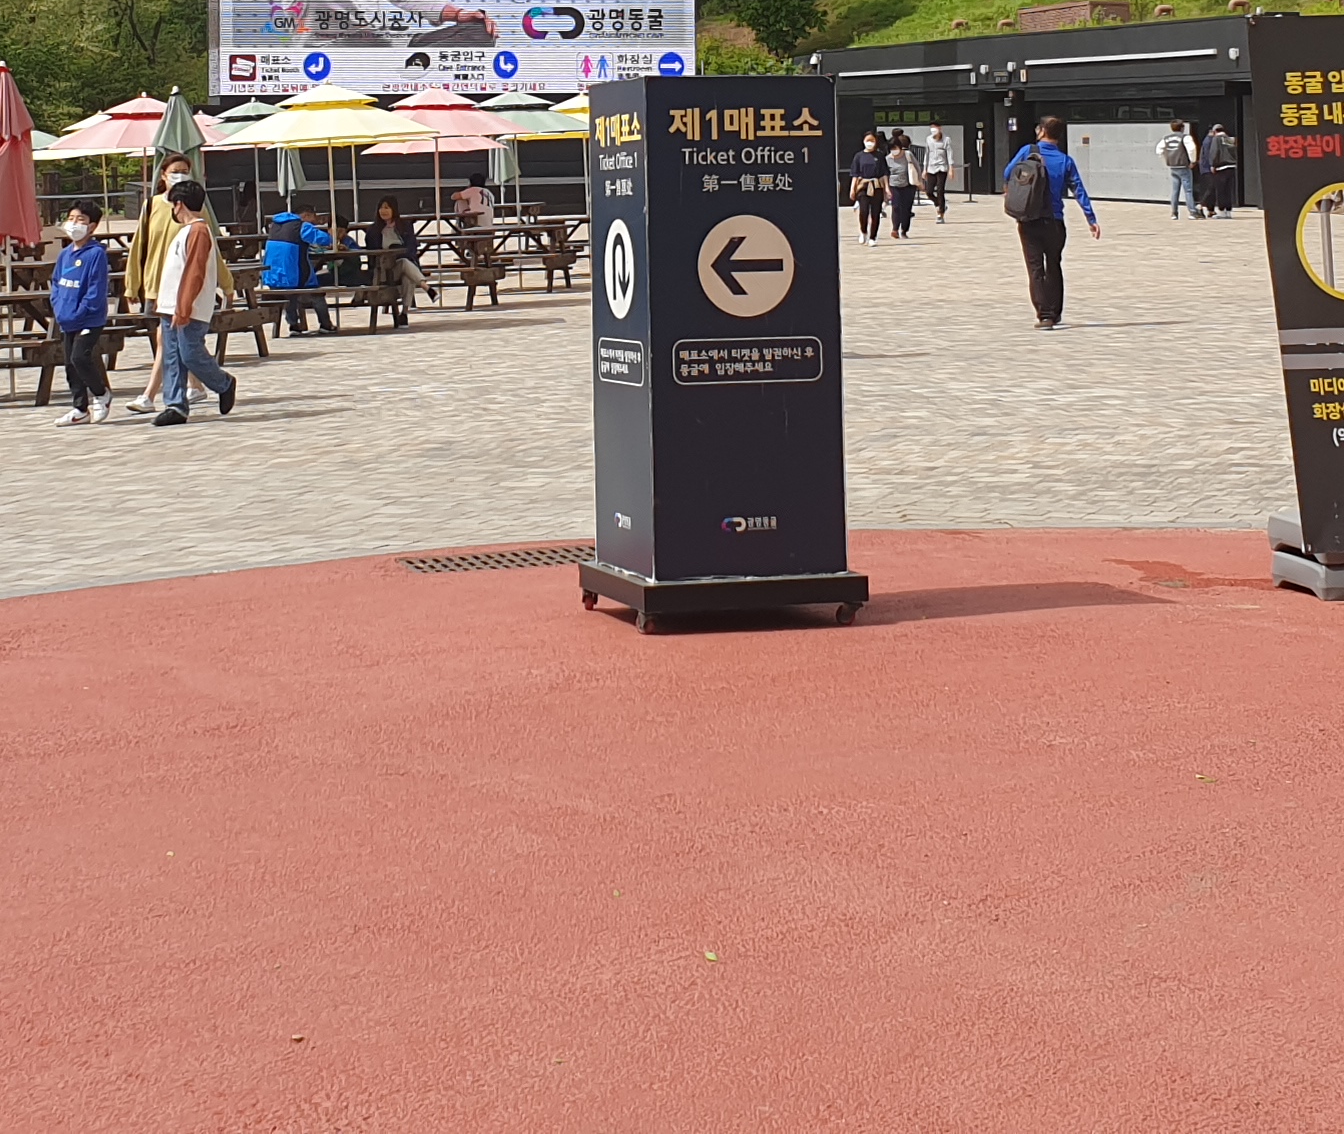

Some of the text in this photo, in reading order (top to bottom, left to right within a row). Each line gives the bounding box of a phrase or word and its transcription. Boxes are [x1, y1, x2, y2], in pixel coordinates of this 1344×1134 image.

[315, 10, 426, 30] 광명도시공사
[588, 8, 663, 31] 광명동굴
[261, 54, 291, 65] 매표소
[438, 51, 485, 62] 동굴입구
[617, 54, 652, 64] 화장실
[1284, 71, 1323, 94] 동굴
[668, 107, 823, 141] 제1매표소
[1280, 103, 1319, 126] 동굴
[595, 111, 642, 148] 제1매표소
[681, 147, 809, 165] Ticket Office 1
[1266, 133, 1342, 158] 화장실이
[702, 173, 793, 192] 第一售票处
